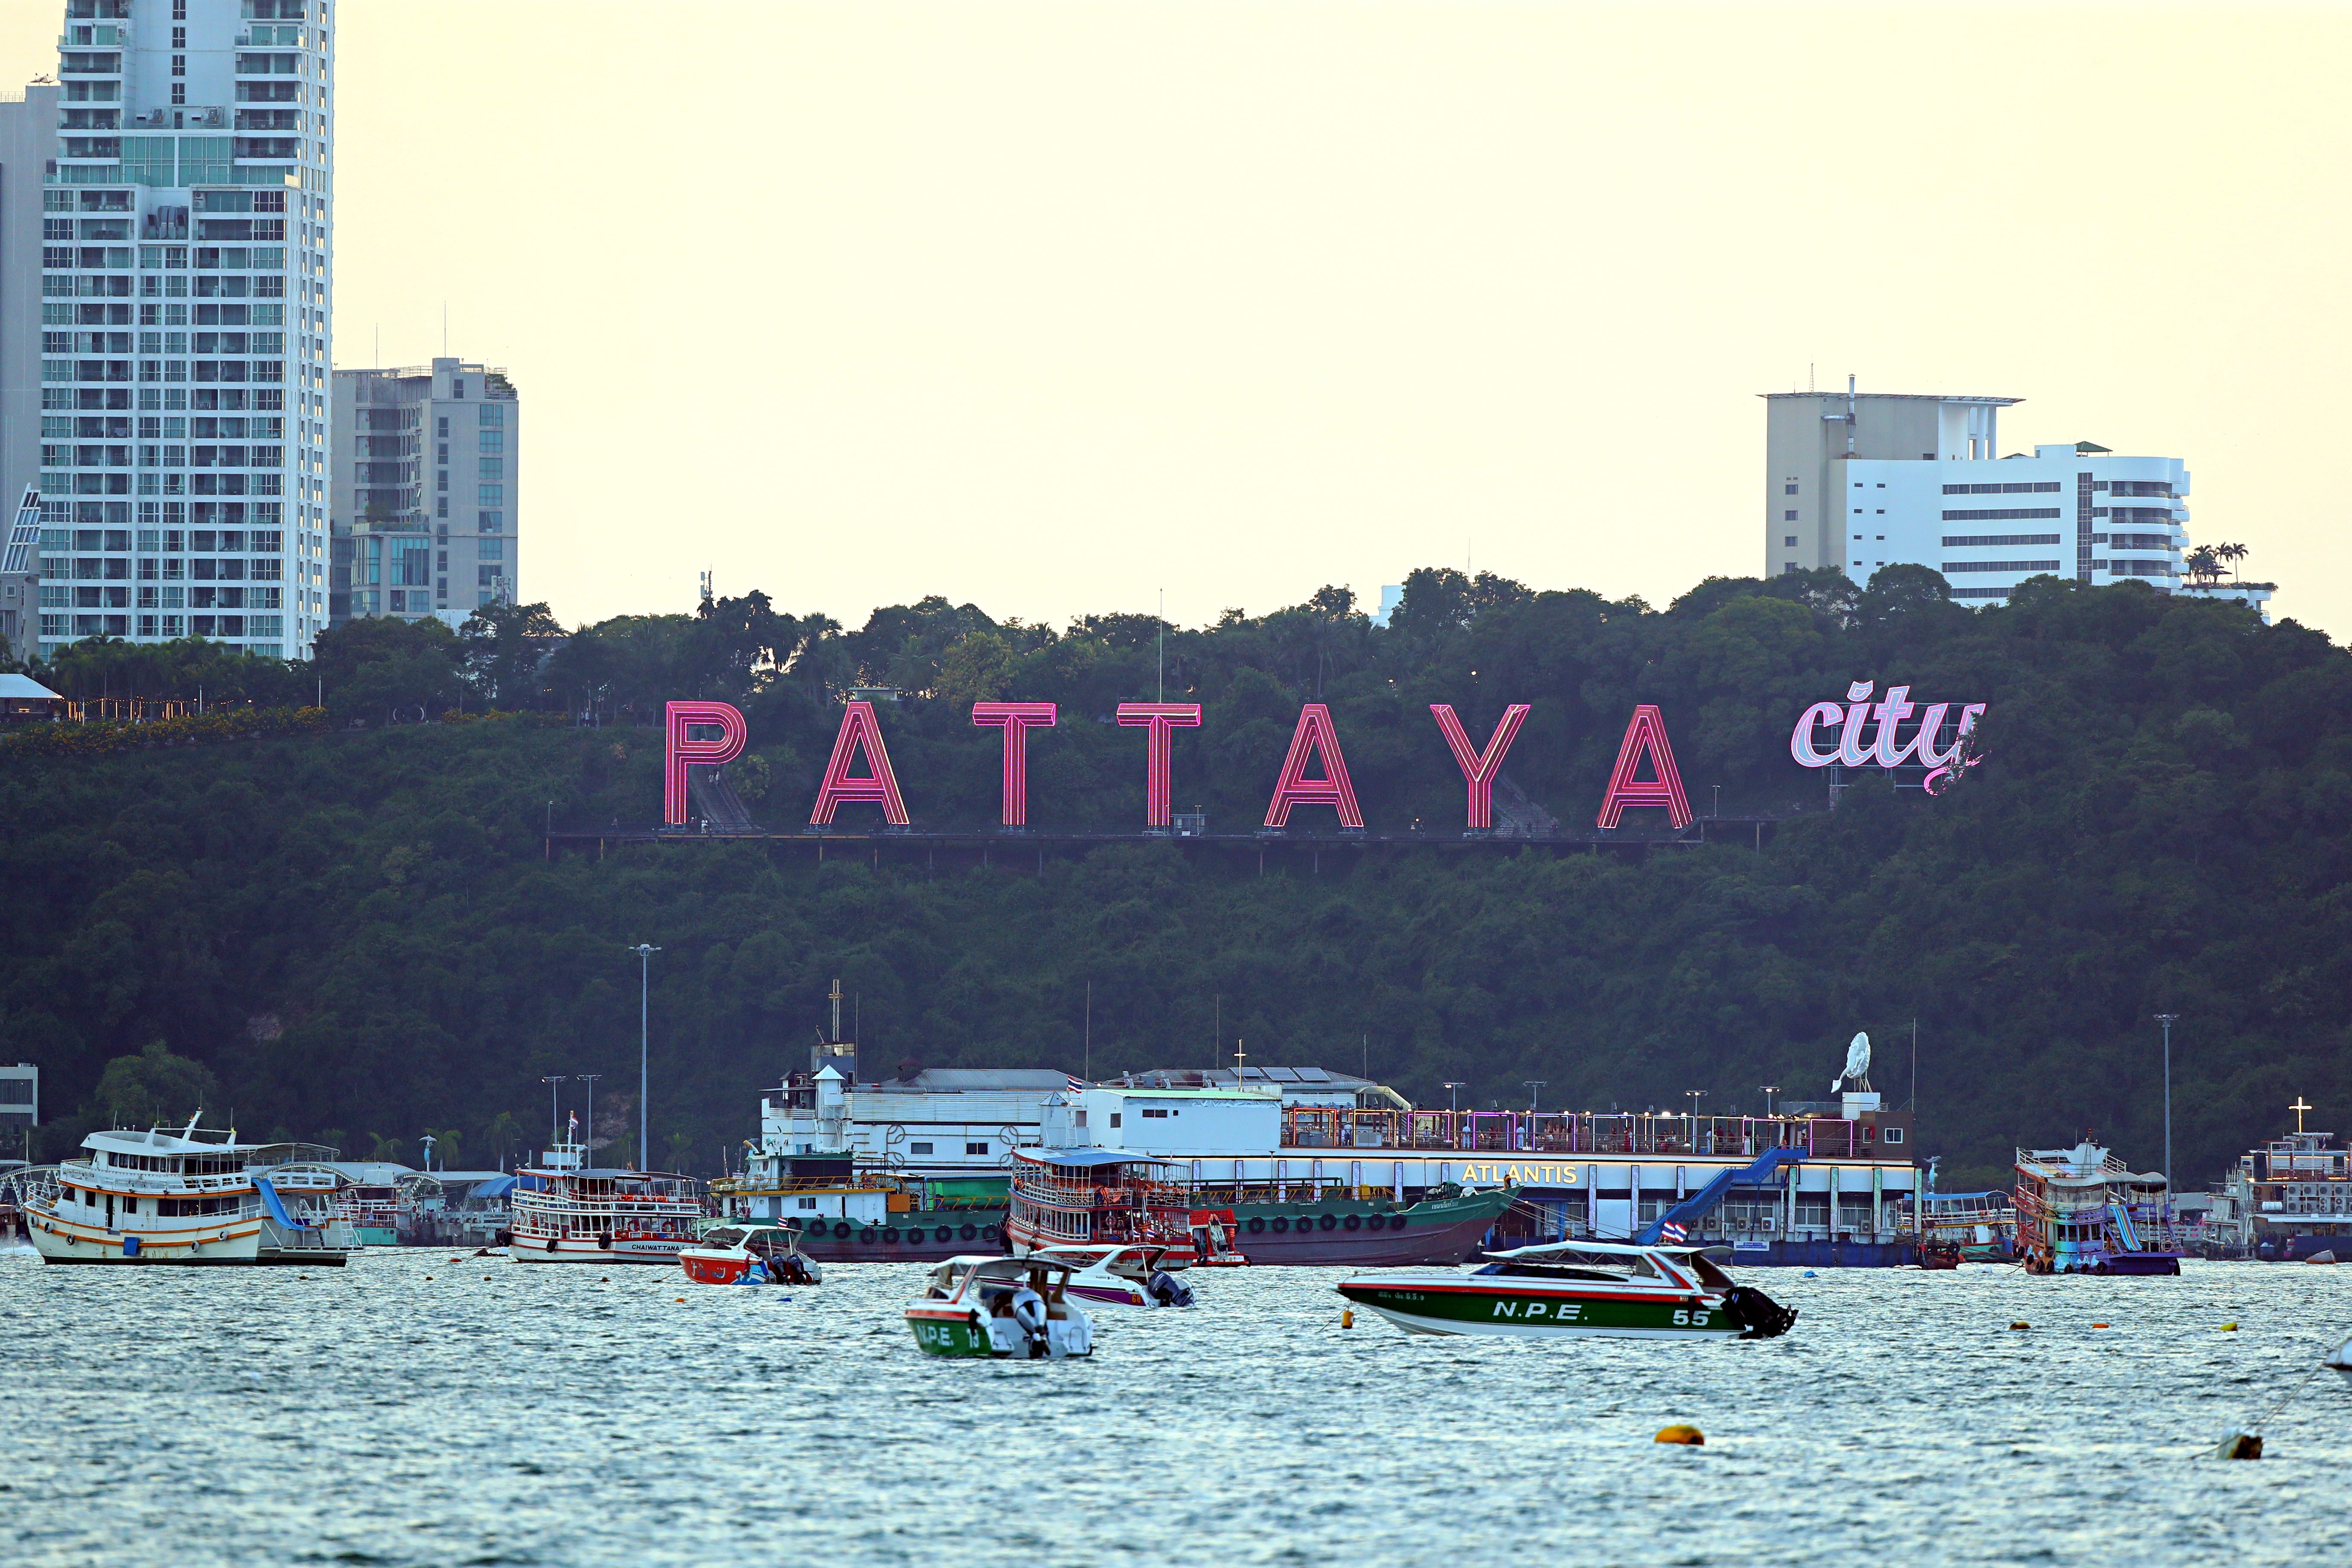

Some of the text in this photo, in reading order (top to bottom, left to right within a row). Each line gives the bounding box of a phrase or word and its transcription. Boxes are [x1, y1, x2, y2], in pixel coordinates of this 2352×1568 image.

[664, 680, 1991, 830] PATTAYA city
[1462, 1164, 1577, 1183] ATLANTIS
[1132, 1295, 1141, 1303] 68
[1493, 1302, 1588, 1320] N.P.E.
[1673, 1310, 1711, 1326] 55
[917, 1324, 954, 1346] N.P.E.
